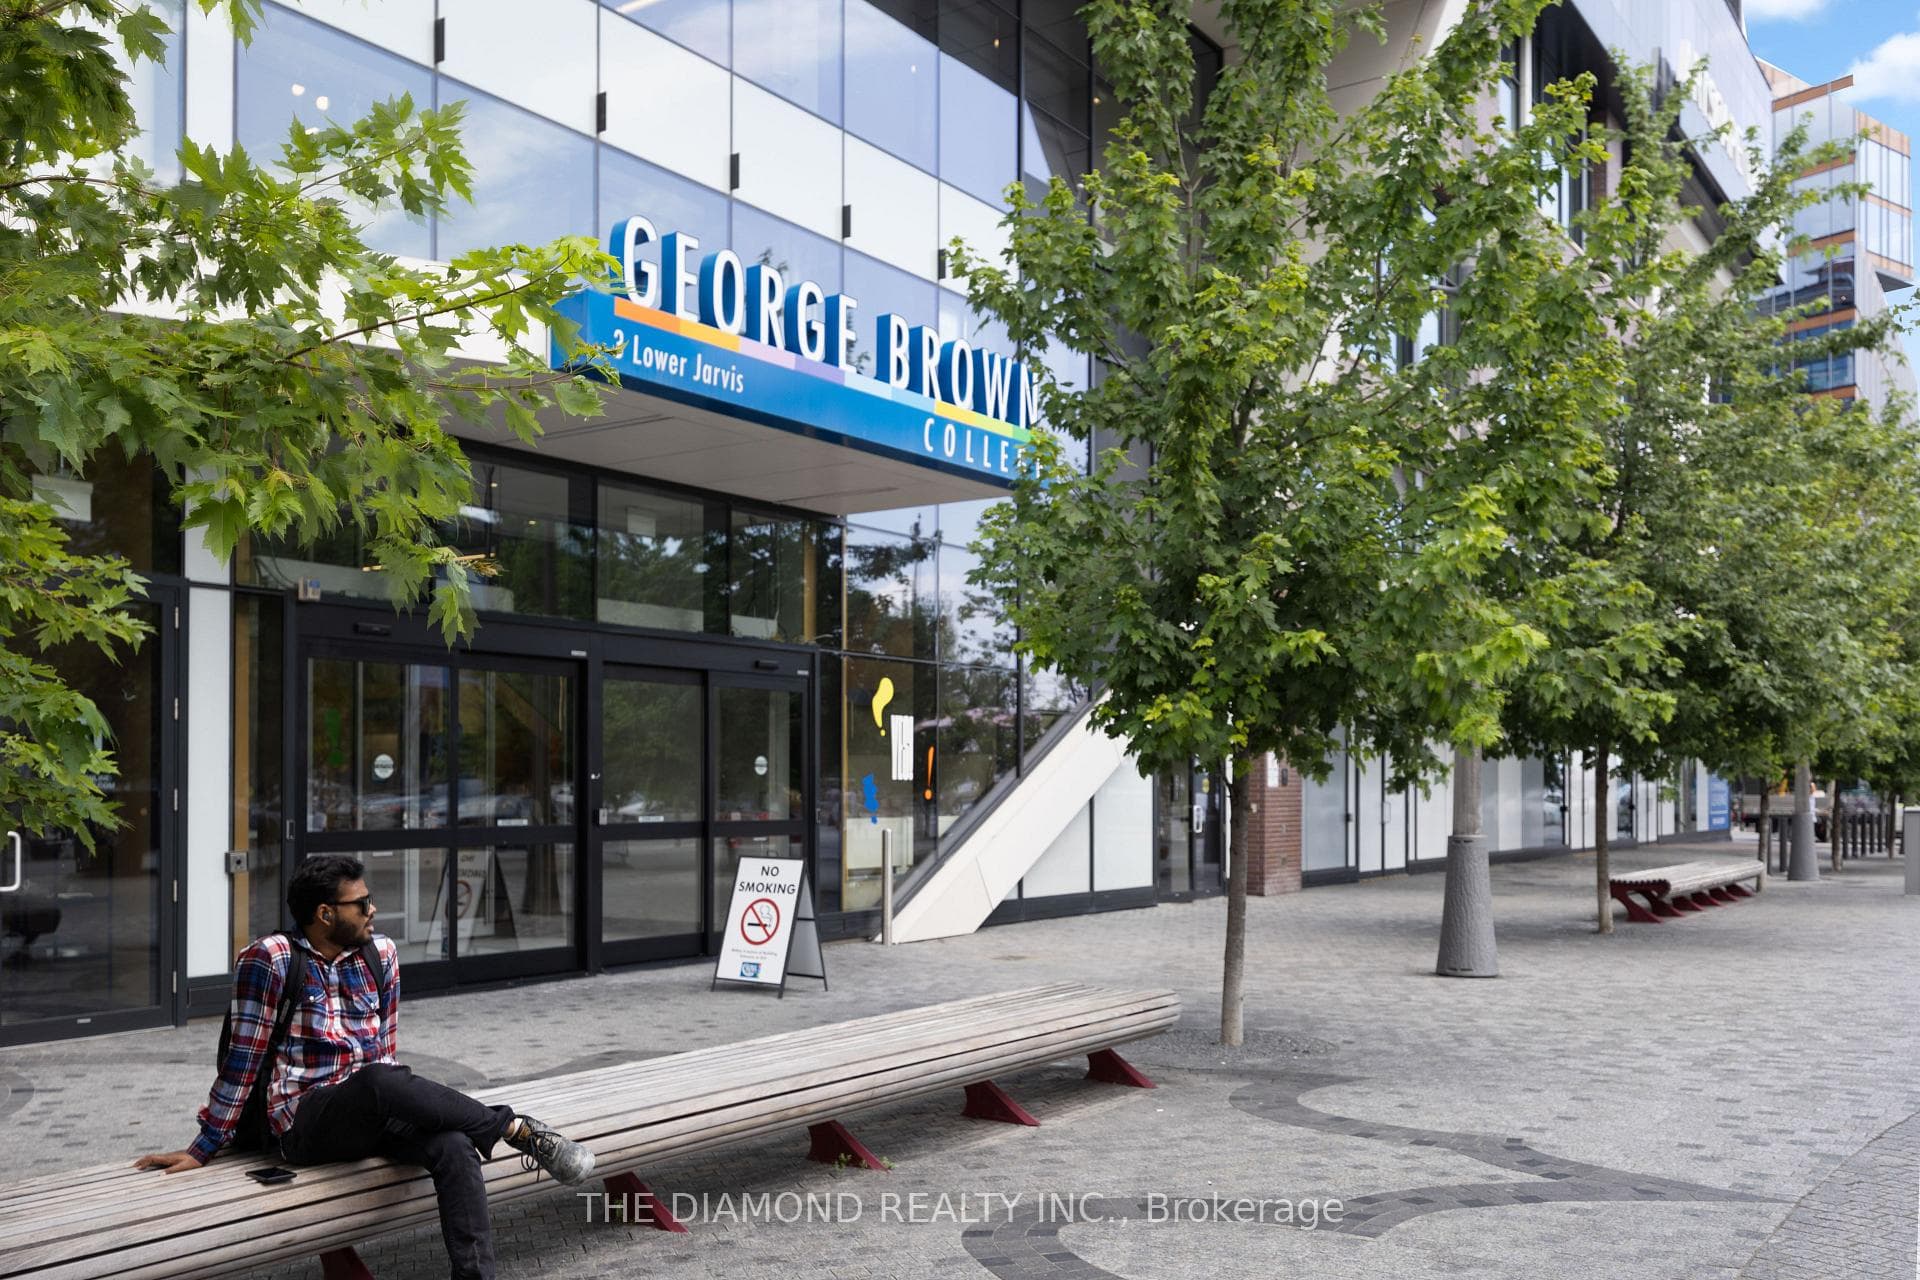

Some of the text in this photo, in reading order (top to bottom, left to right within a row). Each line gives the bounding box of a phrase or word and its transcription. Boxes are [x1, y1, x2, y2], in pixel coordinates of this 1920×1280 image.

[610, 214, 1039, 430] GEORGE BROWN
[632, 334, 688, 377] Lower
[693, 353, 744, 393] Jarvis
[738, 881, 796, 895] SMOKING
[760, 866, 780, 877] NO
